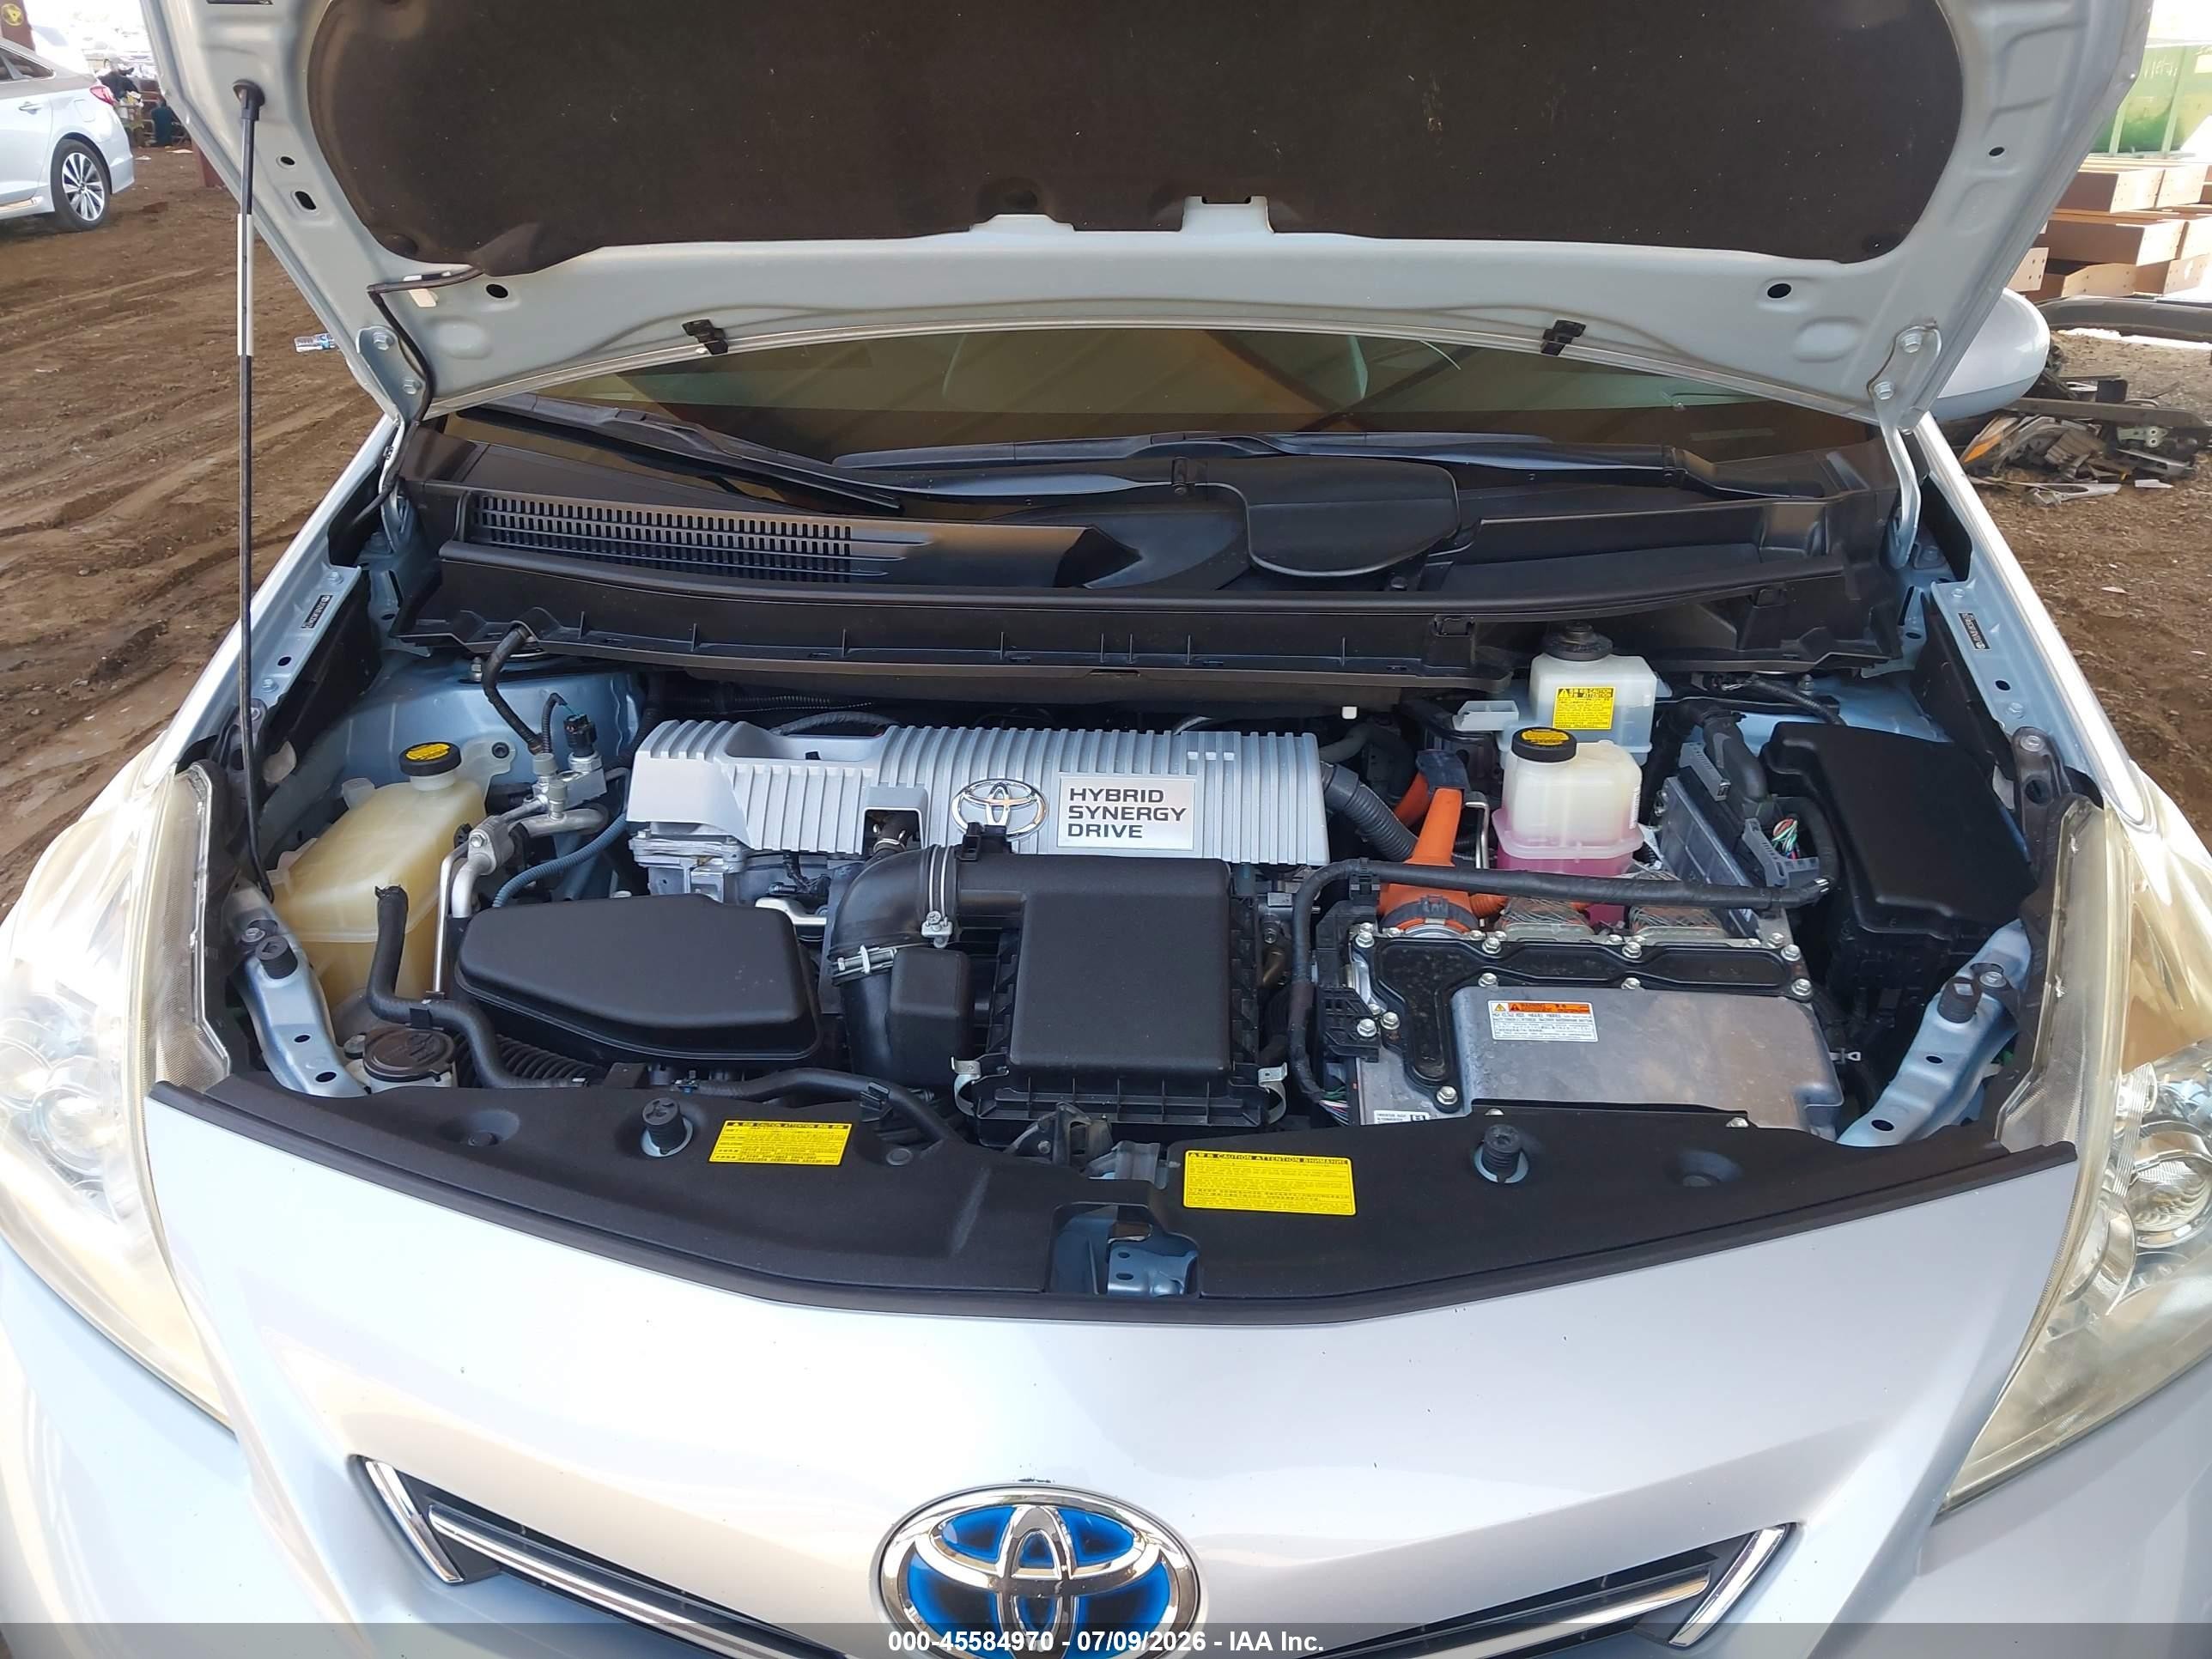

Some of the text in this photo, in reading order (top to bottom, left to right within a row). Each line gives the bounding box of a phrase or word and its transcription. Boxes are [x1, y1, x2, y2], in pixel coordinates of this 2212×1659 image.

[1070, 788, 1164, 803] HYBRID
[1068, 805, 1187, 822] SYNERGY
[1067, 823, 1143, 839] DRIVE
